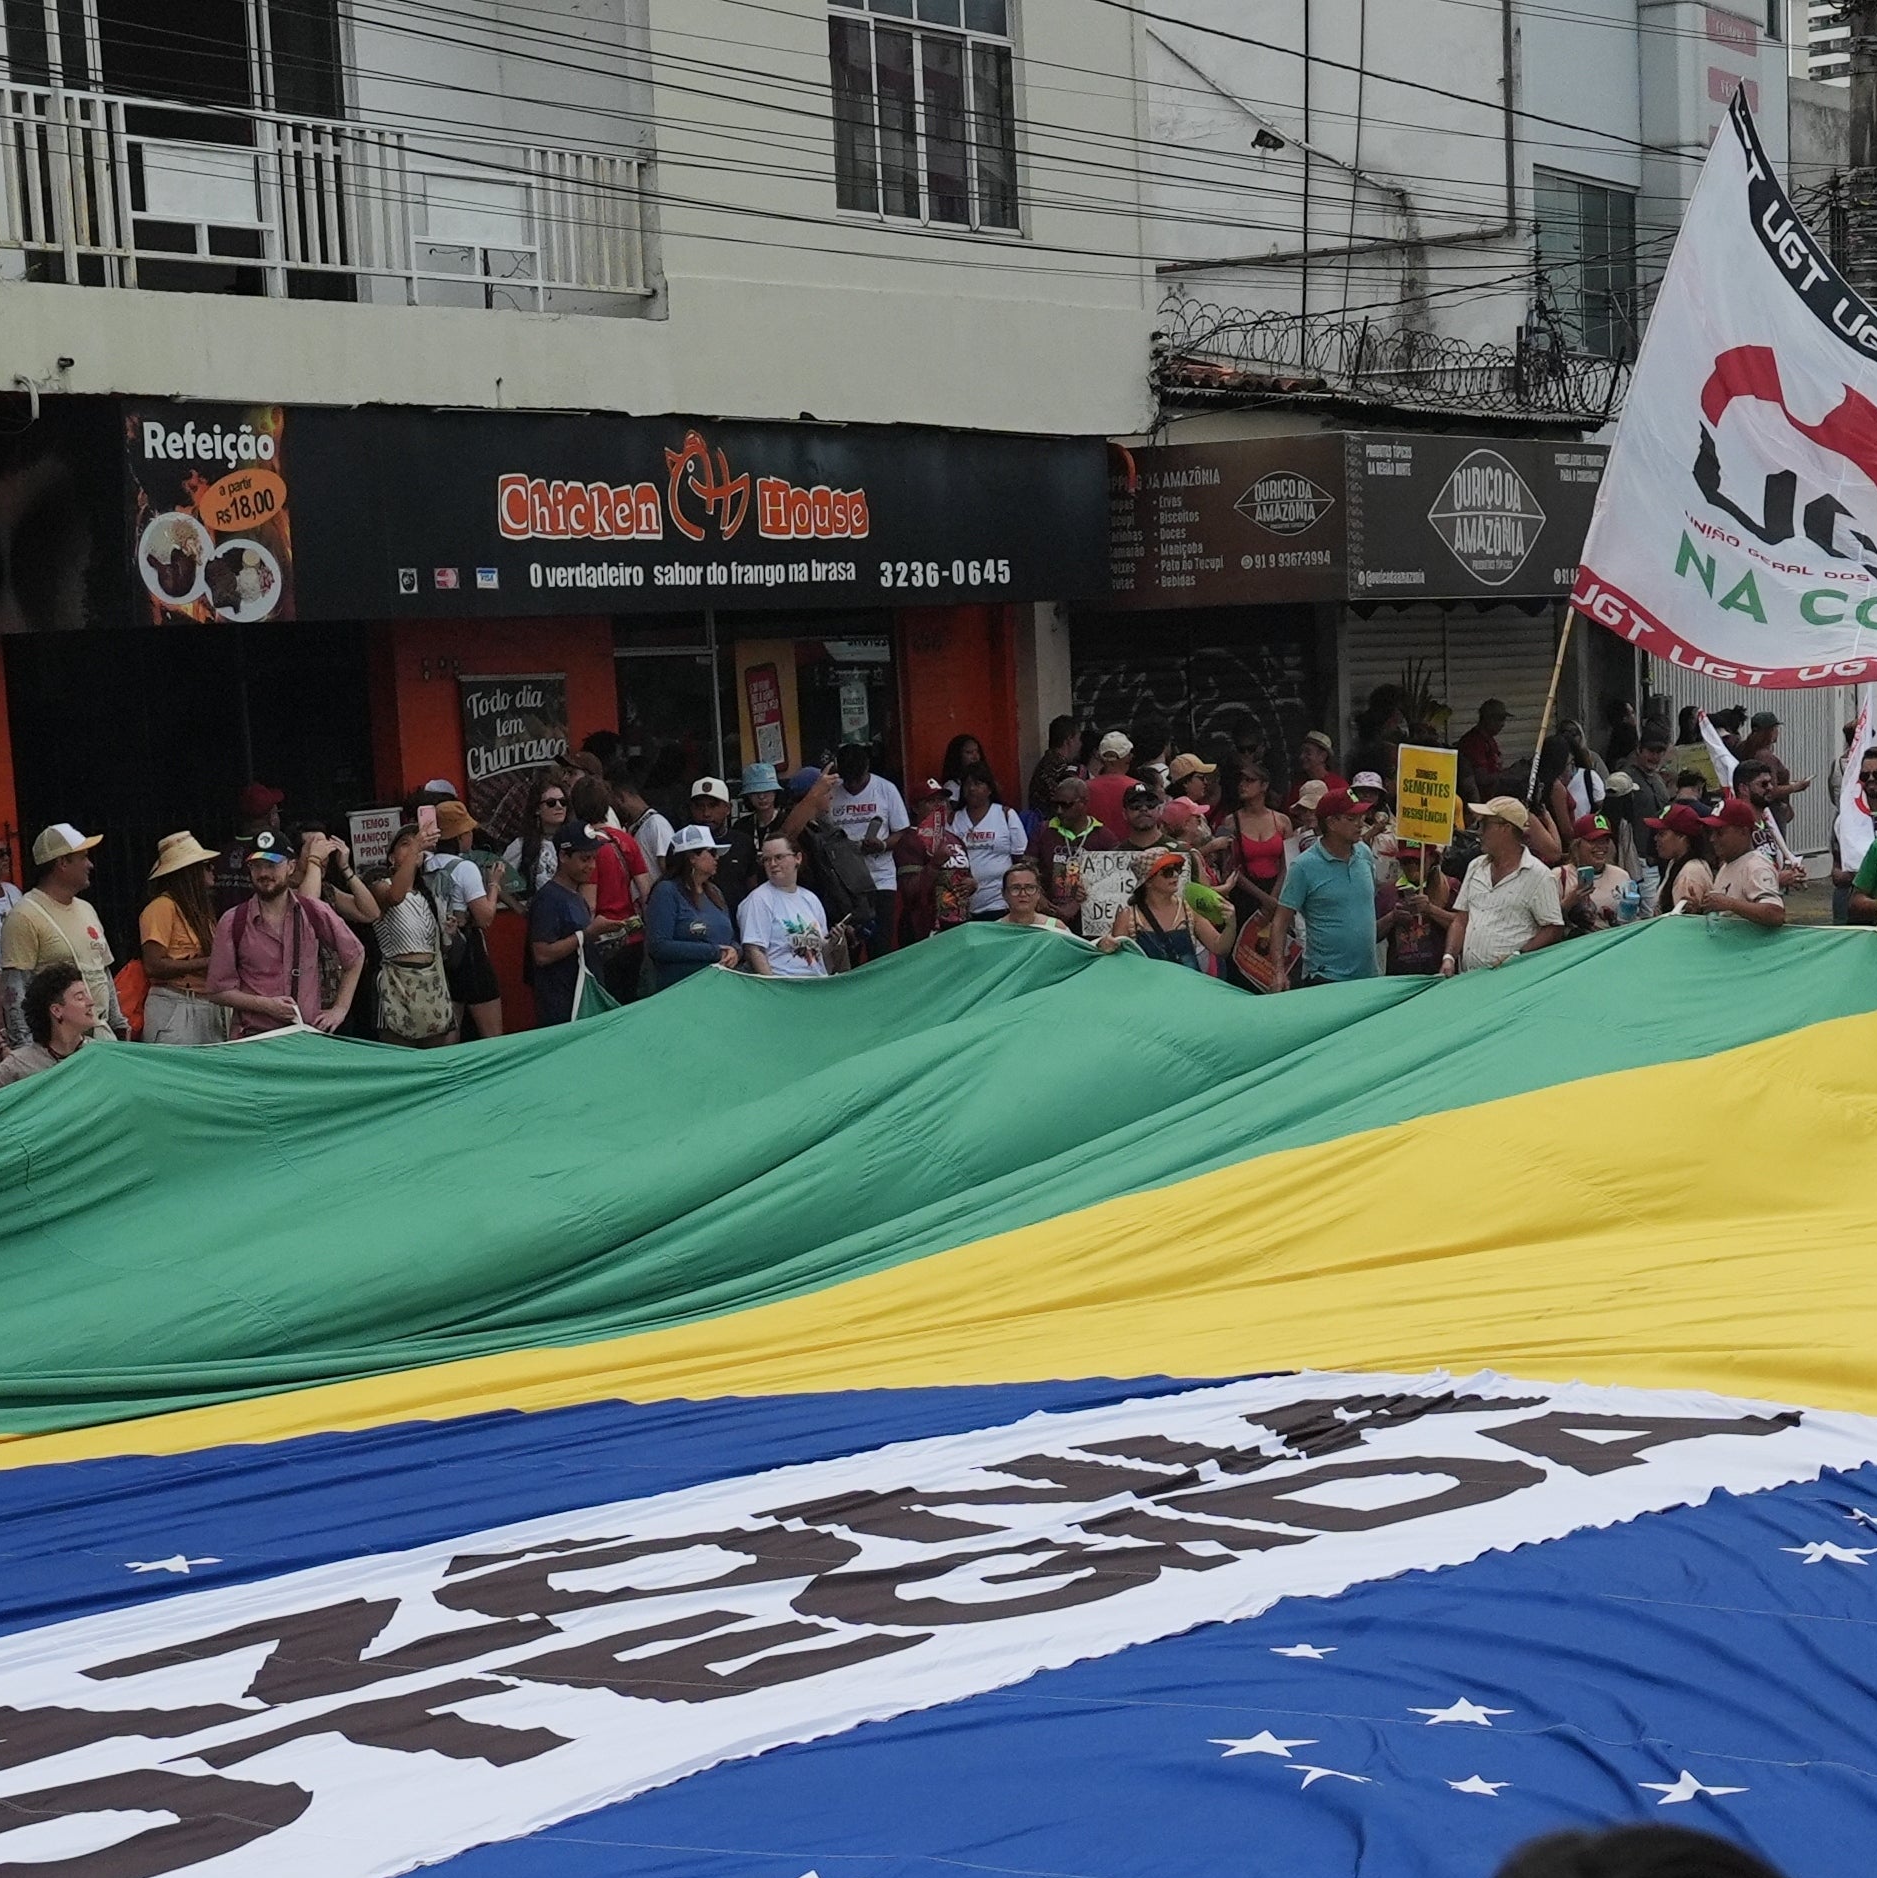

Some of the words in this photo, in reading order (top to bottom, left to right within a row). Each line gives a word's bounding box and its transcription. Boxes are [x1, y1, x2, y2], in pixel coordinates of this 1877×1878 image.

[1762, 199, 1829, 291] UGT
[143, 421, 274, 469] Refeição
[228, 475, 252, 497] partir
[1163, 466, 1221, 488] AMAZÔNIA
[1254, 479, 1296, 502] OURIÇO
[1298, 482, 1312, 499] DA
[1453, 466, 1502, 510] OURIÇO
[1504, 471, 1522, 512] DA
[498, 473, 663, 540] Chicken
[757, 478, 870, 540] House
[1255, 501, 1315, 522] AMAZÔNIA
[1454, 515, 1524, 556] AMAZÔNIA
[1685, 510, 1740, 547] UNIÃO
[1748, 549, 1814, 576] GERAL
[1824, 571, 1870, 582] DOS
[530, 562, 542, 588] O
[546, 562, 644, 589] verdadeiro
[653, 561, 702, 587] sabor
[707, 561, 727, 586] do
[731, 560, 784, 588] frango
[788, 564, 809, 584] na
[812, 559, 856, 583] brasa
[880, 559, 1011, 588] 3236-0645
[1255, 555, 1266, 569] 91
[1675, 529, 1768, 624] NA
[1570, 584, 1655, 641] UGT
[1669, 645, 1776, 685] UGT
[466, 689, 511, 719] Todo
[515, 685, 546, 708] dia
[496, 718, 526, 738] tem
[466, 738, 568, 780] Churrasco
[1403, 778, 1450, 798] SEMENTES
[361, 818, 389, 829] TEMOS
[361, 845, 389, 858] PRONT
[1083, 857, 1095, 873] A
